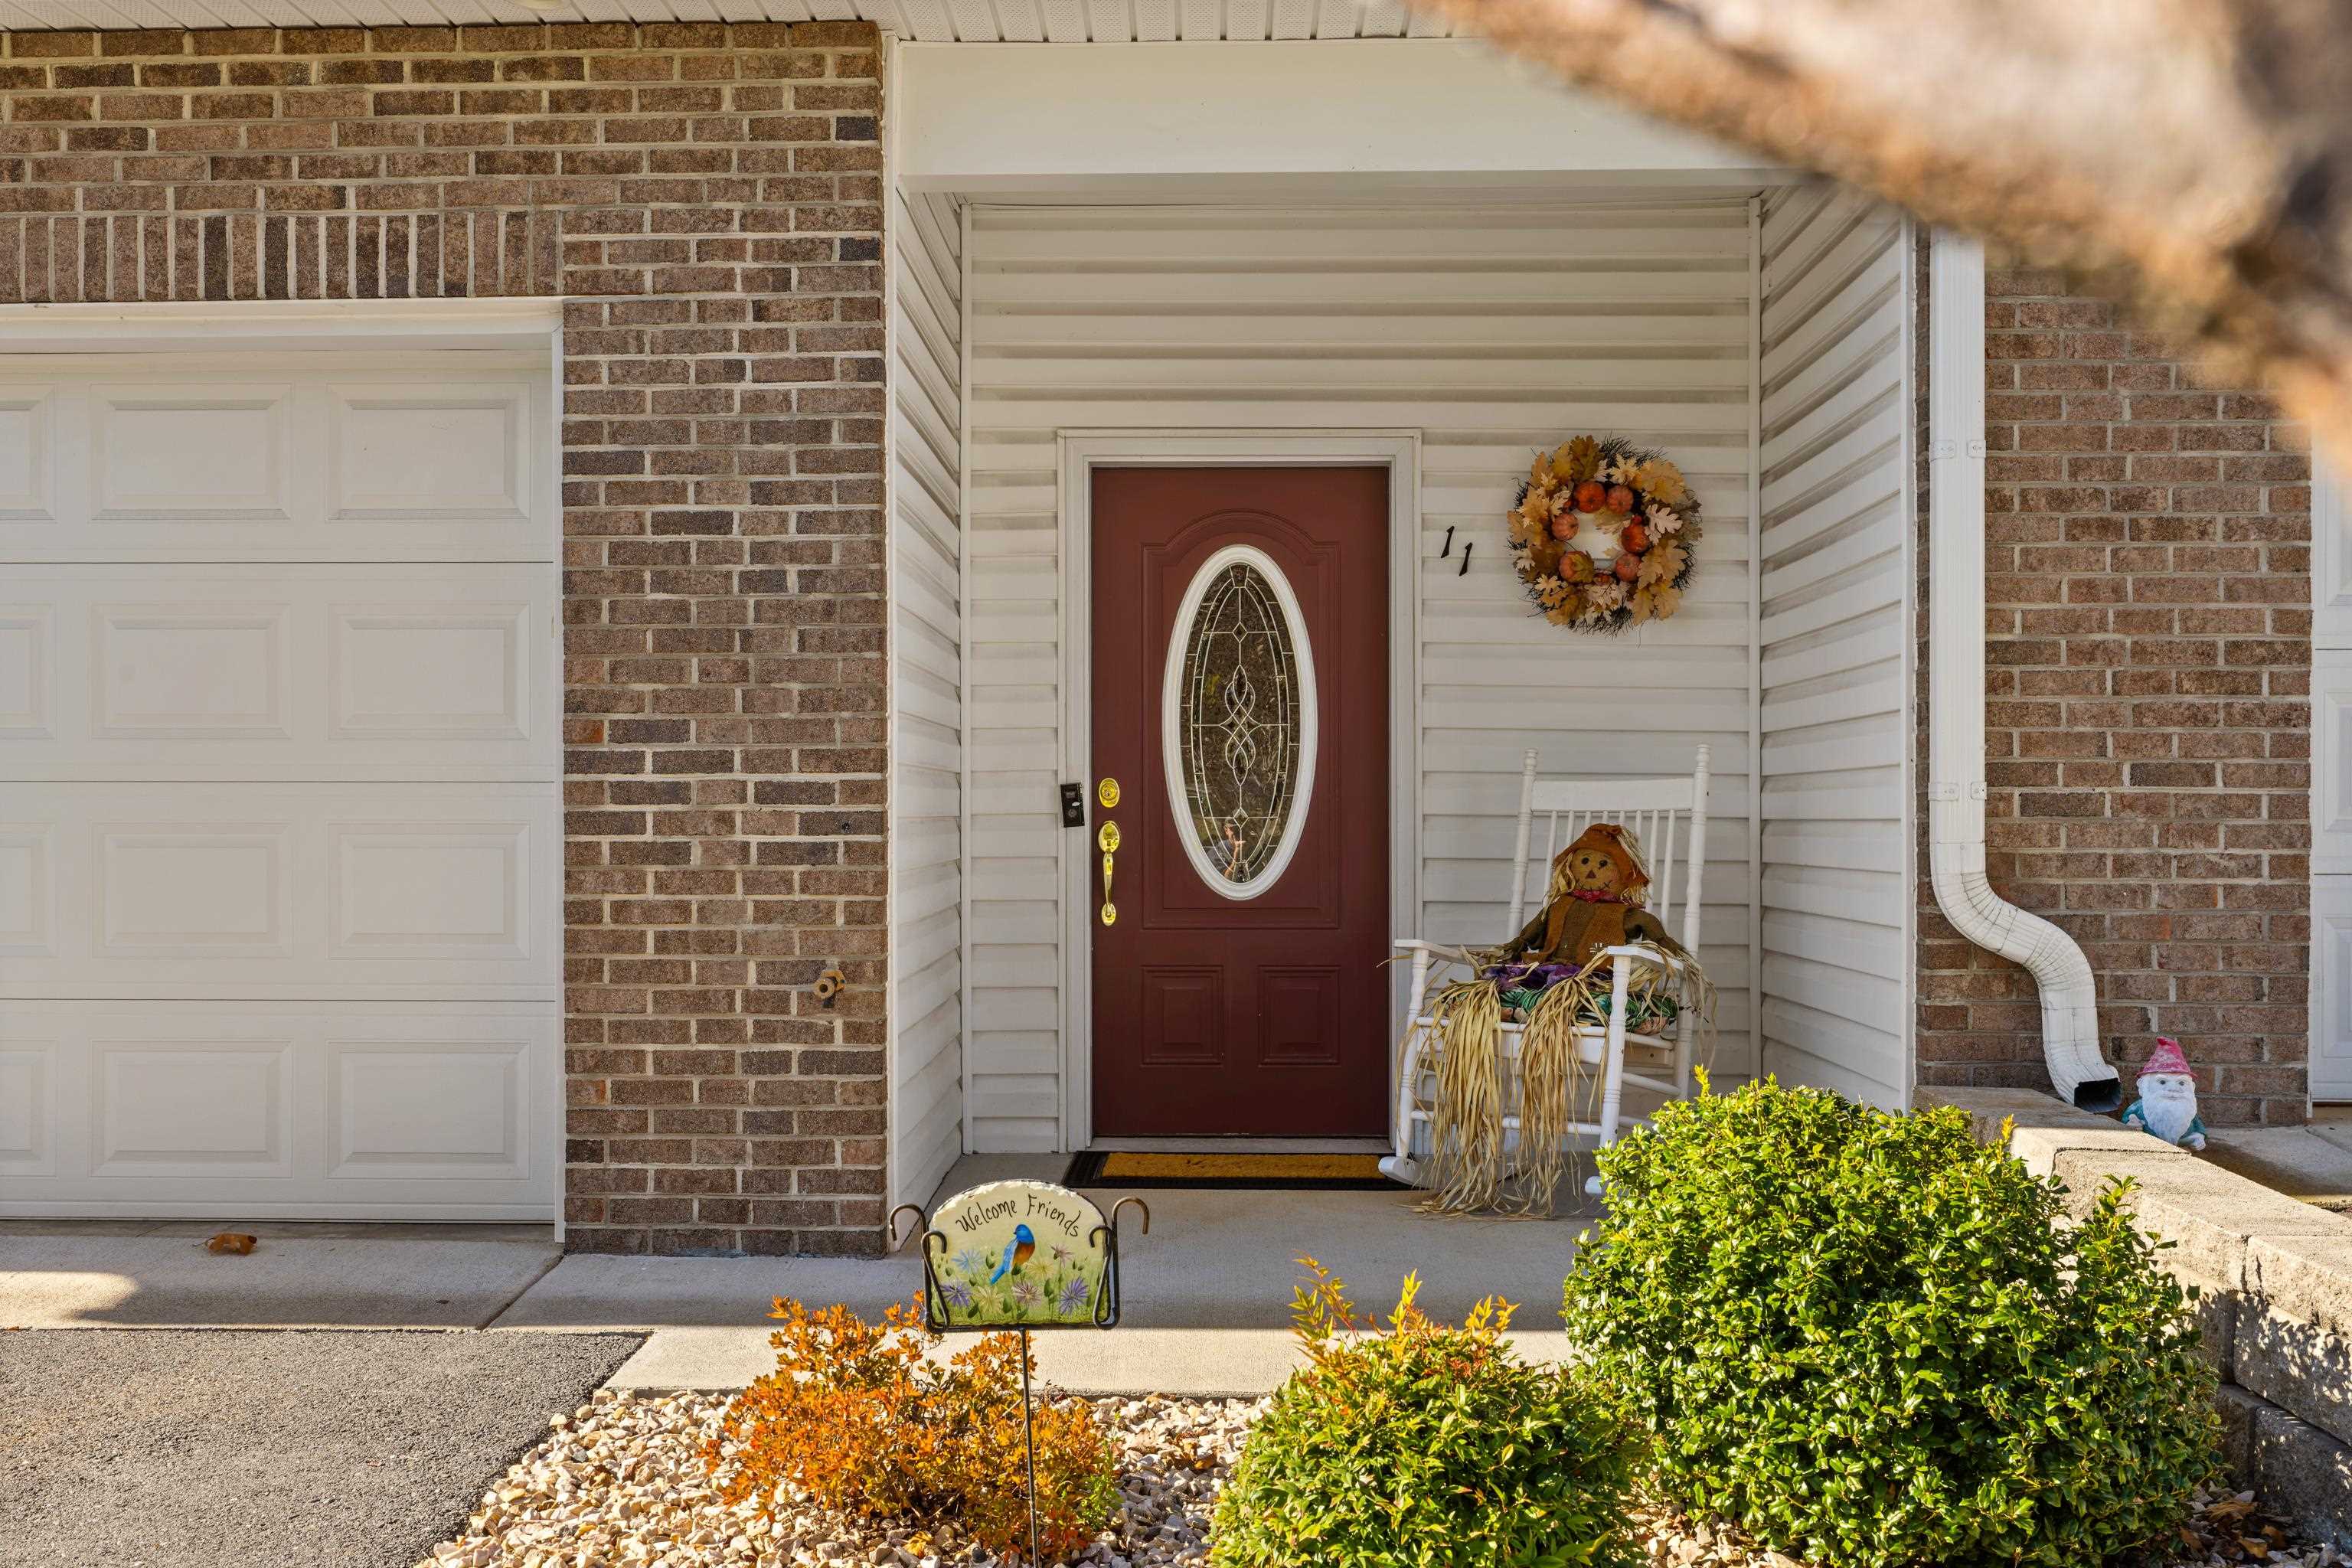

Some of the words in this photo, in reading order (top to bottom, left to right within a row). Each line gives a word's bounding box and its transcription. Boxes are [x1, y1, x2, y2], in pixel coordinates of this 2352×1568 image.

[1440, 525, 1473, 577] 11
[956, 1200, 1018, 1232] Welcome
[1027, 1194, 1081, 1237] Friends
